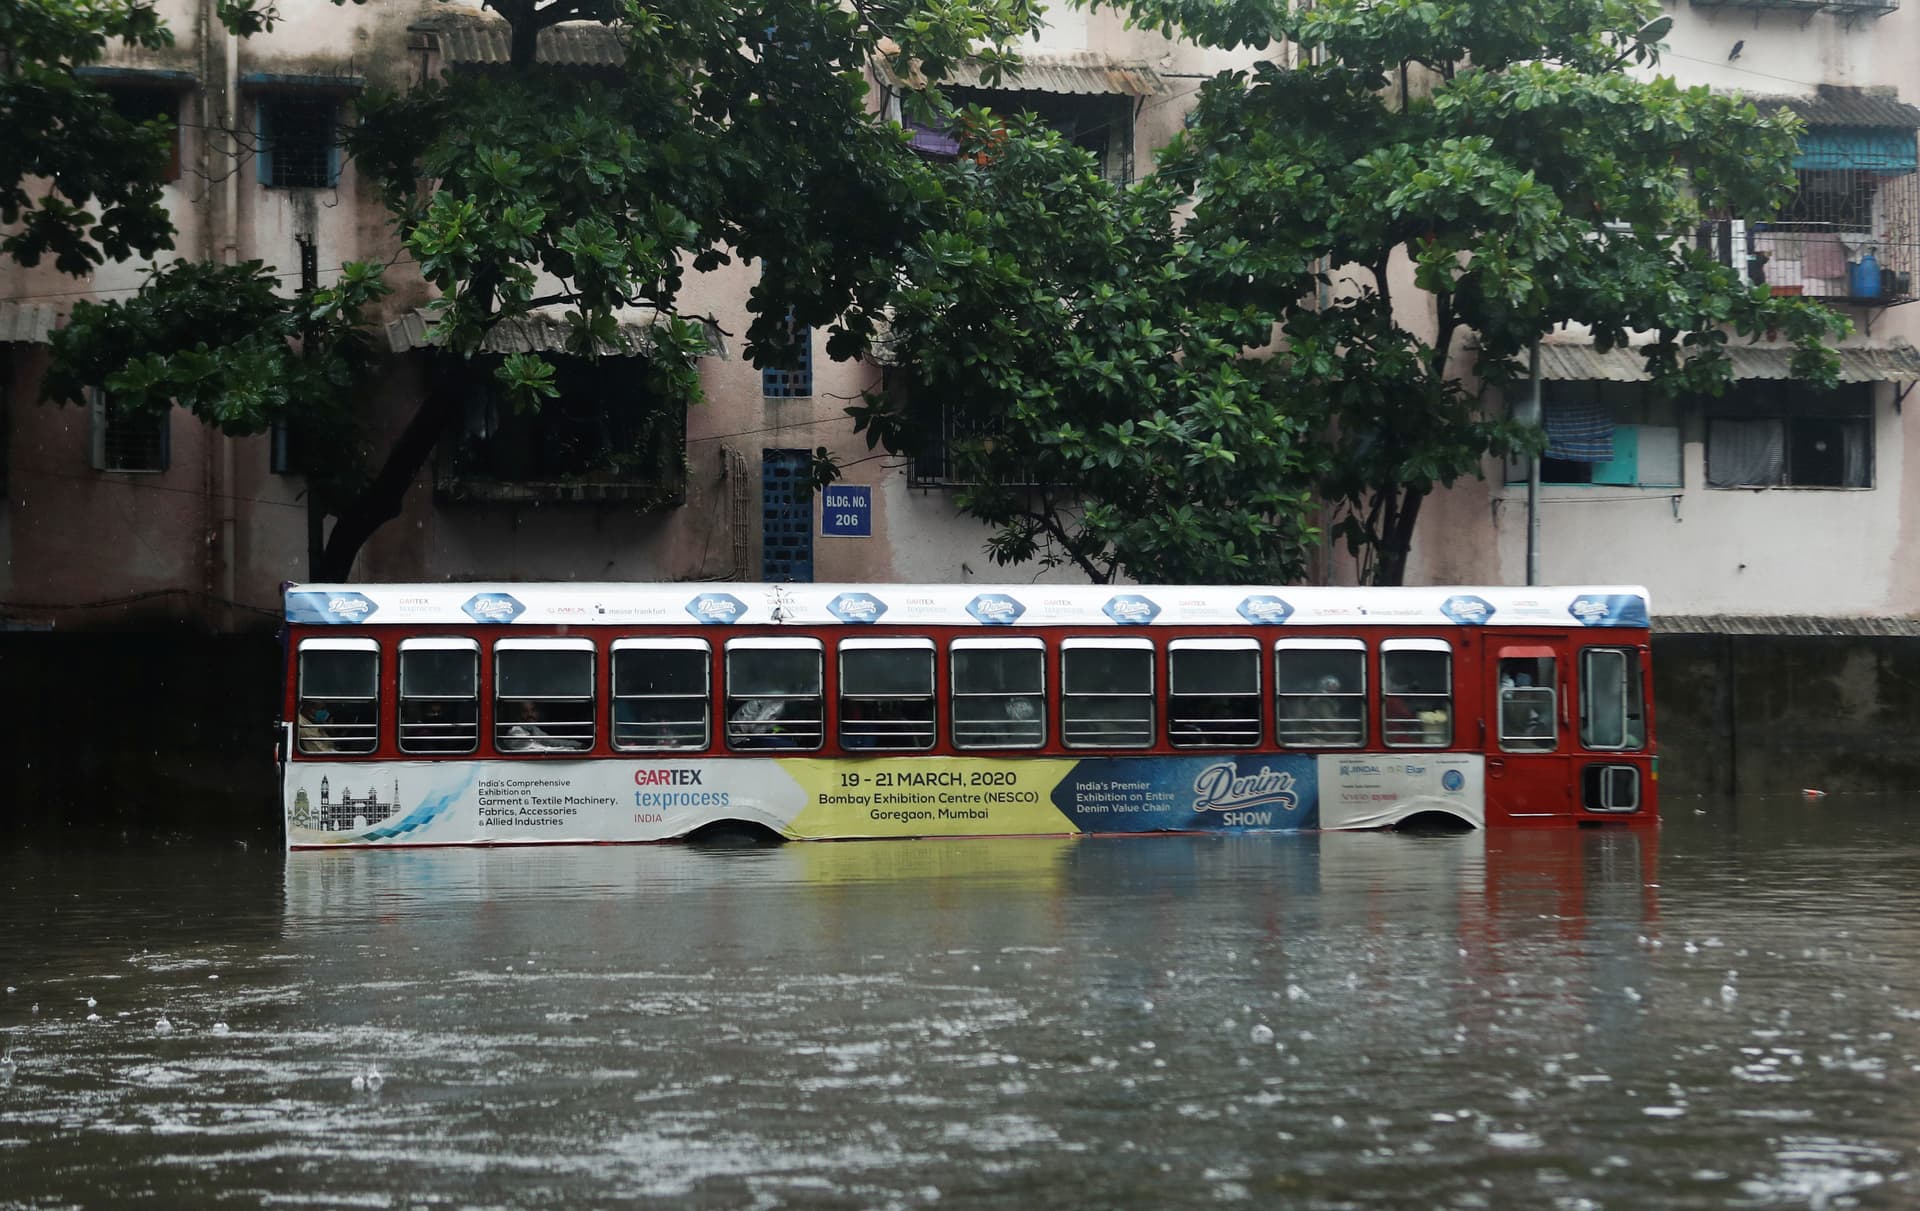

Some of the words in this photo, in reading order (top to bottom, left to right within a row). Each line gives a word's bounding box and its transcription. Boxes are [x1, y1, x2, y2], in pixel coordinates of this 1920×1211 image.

[826, 495, 851, 508] BLDG.
[852, 495, 867, 508] NO.
[835, 514, 859, 526] 206
[634, 769, 702, 786] GARTEX
[841, 773, 860, 787] 19
[875, 772, 894, 787] 21
[897, 772, 967, 788] MARCH,
[971, 772, 1017, 786] 2020
[478, 779, 505, 788] India's
[506, 779, 571, 790] Comprehensive
[1075, 781, 1109, 791] India's
[1111, 781, 1151, 791] Premier
[1193, 761, 1298, 811] Denim
[478, 788, 520, 797] Exhibition
[818, 793, 870, 806] Bombay
[873, 792, 936, 804] Exhibition
[938, 792, 981, 804] Centre
[983, 791, 1040, 804] (NESCO)
[1076, 791, 1127, 802] Exhibition
[1130, 793, 1143, 801] on
[1146, 791, 1175, 801] Entire
[478, 797, 523, 806] Garment
[531, 796, 563, 806] Textile
[634, 790, 729, 811] texprocess
[478, 807, 517, 817] Fabrics,
[518, 806, 578, 816] Accessories
[1076, 803, 1110, 814] Denim
[1112, 803, 1140, 813] Value
[1143, 802, 1171, 813] Chain
[634, 813, 663, 823] INDIA
[870, 809, 935, 823] Goregaon,
[938, 807, 989, 820] Mumbai
[1223, 812, 1272, 826] SHOW
[485, 817, 513, 827] Allied
[514, 817, 564, 826] Industries
